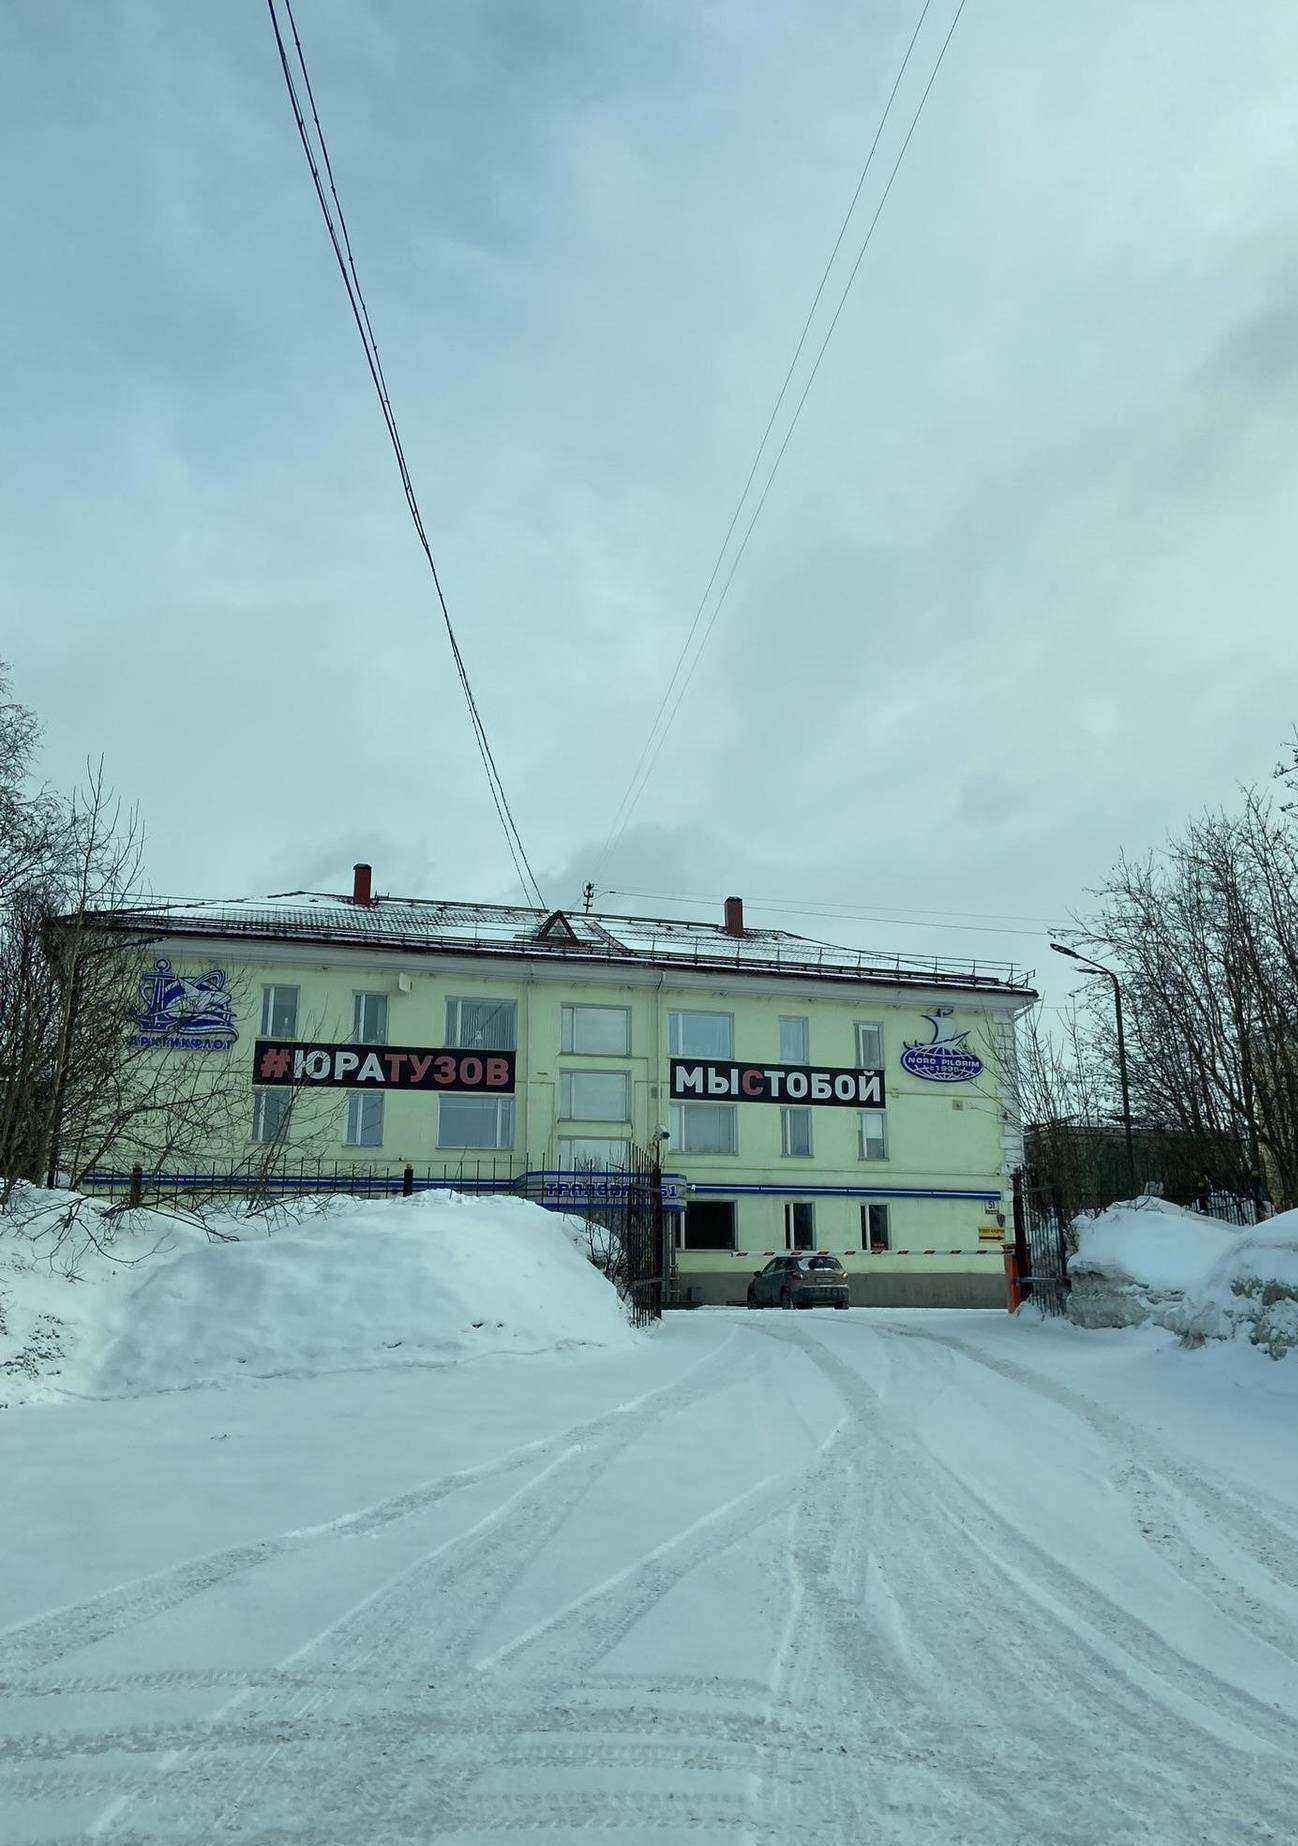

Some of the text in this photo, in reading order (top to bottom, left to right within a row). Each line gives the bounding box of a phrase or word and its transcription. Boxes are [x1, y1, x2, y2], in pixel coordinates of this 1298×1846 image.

[260, 1048, 510, 1086] #ЮРАТУЗОВ
[907, 1057, 980, 1068] NORD PILGRIM
[675, 1066, 881, 1102] МЫСТОБОЙ
